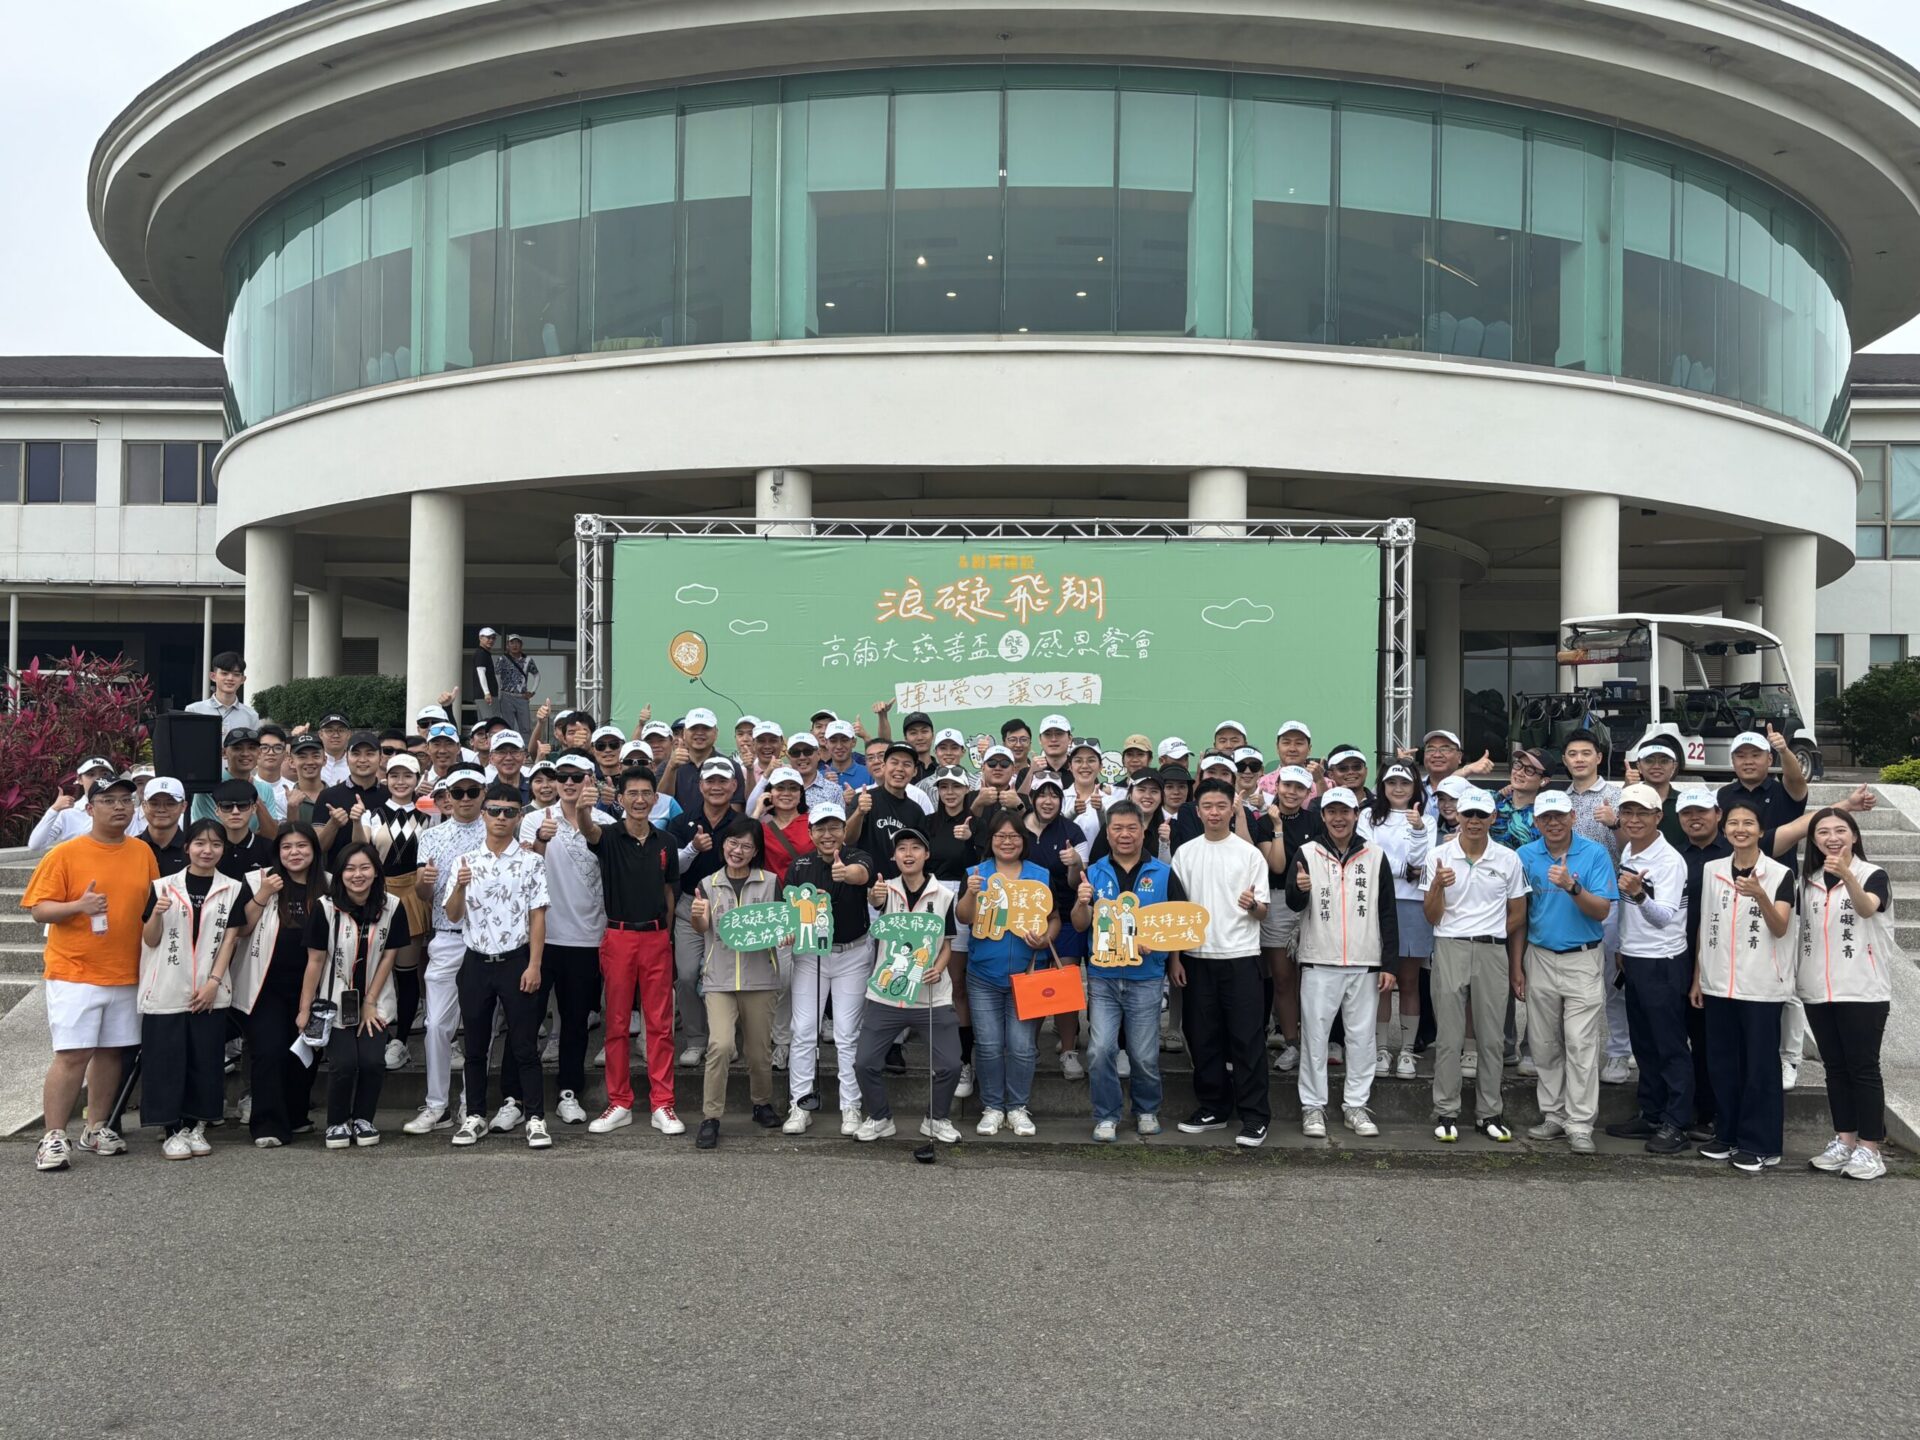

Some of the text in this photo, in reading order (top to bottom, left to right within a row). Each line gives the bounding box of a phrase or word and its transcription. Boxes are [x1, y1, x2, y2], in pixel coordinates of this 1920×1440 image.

[876, 573, 1106, 623] 浪礙飛翔
[1687, 742, 1705, 760] 22
[876, 816, 906, 828] Callaw
[1354, 863, 1367, 918] 浪礙長青
[723, 905, 790, 929] 浪礙長青
[874, 915, 942, 935] 浪礙飛翔
[1142, 911, 1202, 928] 扶持生活
[1748, 897, 1762, 949] 礙長青
[1840, 898, 1855, 959] 浪礙長青
